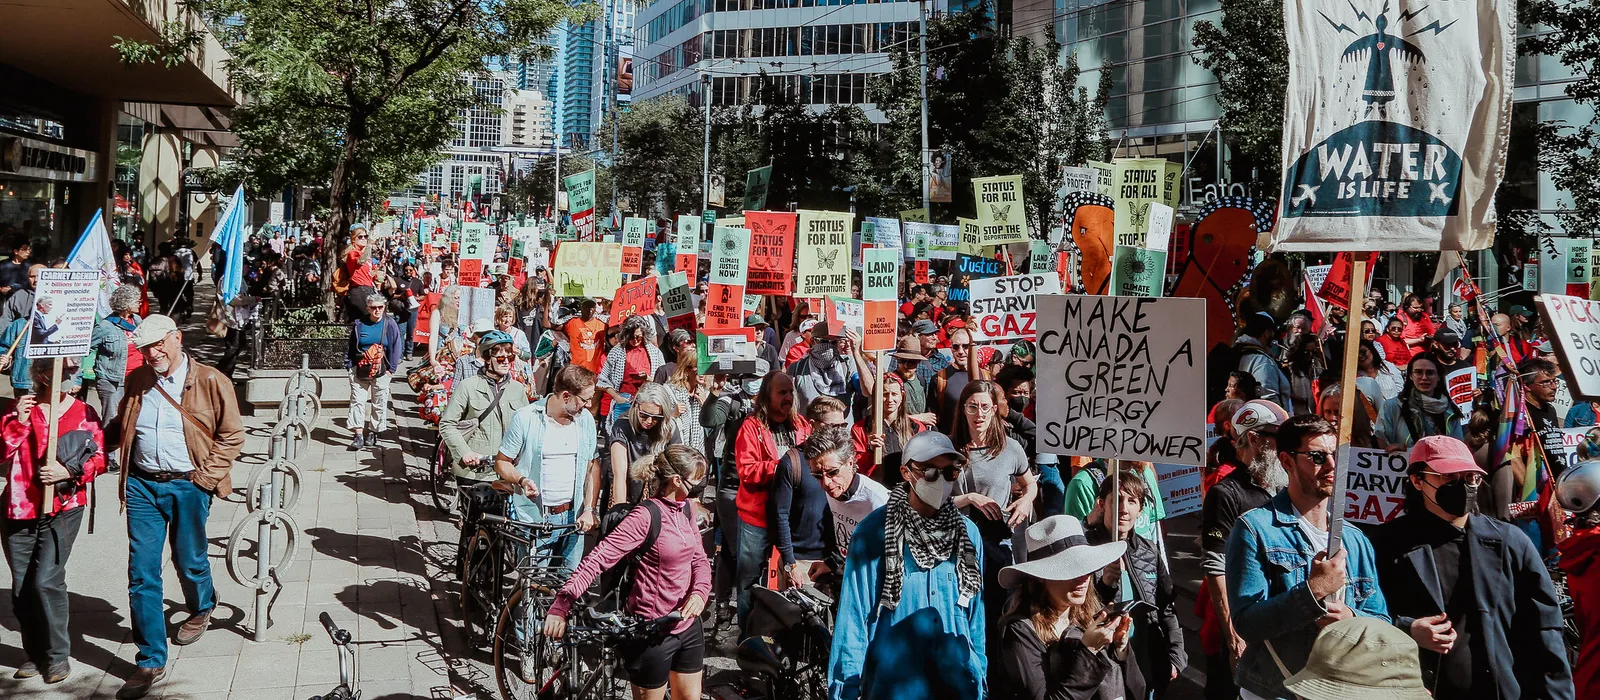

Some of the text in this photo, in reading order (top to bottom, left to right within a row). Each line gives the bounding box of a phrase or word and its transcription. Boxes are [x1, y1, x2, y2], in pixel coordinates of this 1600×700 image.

[1317, 141, 1447, 182] WATER
[1123, 169, 1157, 183] STATUS
[568, 182, 582, 191] UNITE
[982, 181, 1015, 192] STATUS
[1066, 178, 1091, 190] PROECT
[1337, 181, 1411, 199] IS LIFE
[572, 187, 589, 196] JUSTICE
[981, 191, 1017, 203] FOR ALL
[1120, 184, 1139, 199] FOR
[1140, 184, 1158, 199] ALL
[1189, 177, 1250, 205] Eato
[809, 220, 844, 232] STATUS
[983, 224, 1021, 234] STOP THE
[753, 234, 784, 246] STATUS
[807, 233, 845, 246] FOR ALL
[935, 238, 959, 247] Learner
[963, 233, 977, 244] FOR
[983, 233, 1022, 241] DEPORTATIONS
[1118, 233, 1139, 246] STOP
[561, 243, 621, 268] LOVE
[752, 246, 782, 257] FOR ALL
[1033, 253, 1048, 262] LAND
[718, 263, 740, 271] JUSTICE
[868, 261, 895, 274] LAND
[1032, 262, 1047, 270] BACK
[42, 271, 99, 280] CARNEY AGENDA
[718, 270, 739, 279] NOW!
[748, 271, 784, 280] DIGNITY FOR
[805, 274, 846, 286] STOP THE
[747, 280, 785, 290] MIGRANTS
[868, 275, 894, 288] BACK
[994, 276, 1045, 294] STOP
[1122, 282, 1150, 293] CLIMATE
[669, 286, 682, 296] LET
[804, 285, 846, 294] DEPORTATIONS
[1327, 281, 1345, 296] STOP
[667, 293, 687, 305] GAZA
[972, 294, 1036, 314] STARVI
[617, 300, 654, 322] FOR ALL
[670, 303, 687, 312] LIVE
[712, 304, 724, 312] END
[1550, 295, 1599, 324] PICK
[707, 310, 740, 320] FOSSIL FUEL
[1064, 297, 1157, 333] MAKE
[980, 312, 1036, 337] GAZ
[29, 347, 46, 356] STOP
[47, 346, 60, 354] THE
[1039, 329, 1194, 367] CANADA A
[1065, 359, 1170, 397] GREEN
[1065, 392, 1161, 428] ENERGY
[1357, 452, 1407, 473] STO
[1158, 466, 1198, 480] Eighty million and
[1170, 486, 1195, 499] Workers
[1344, 491, 1406, 523] GAZ
